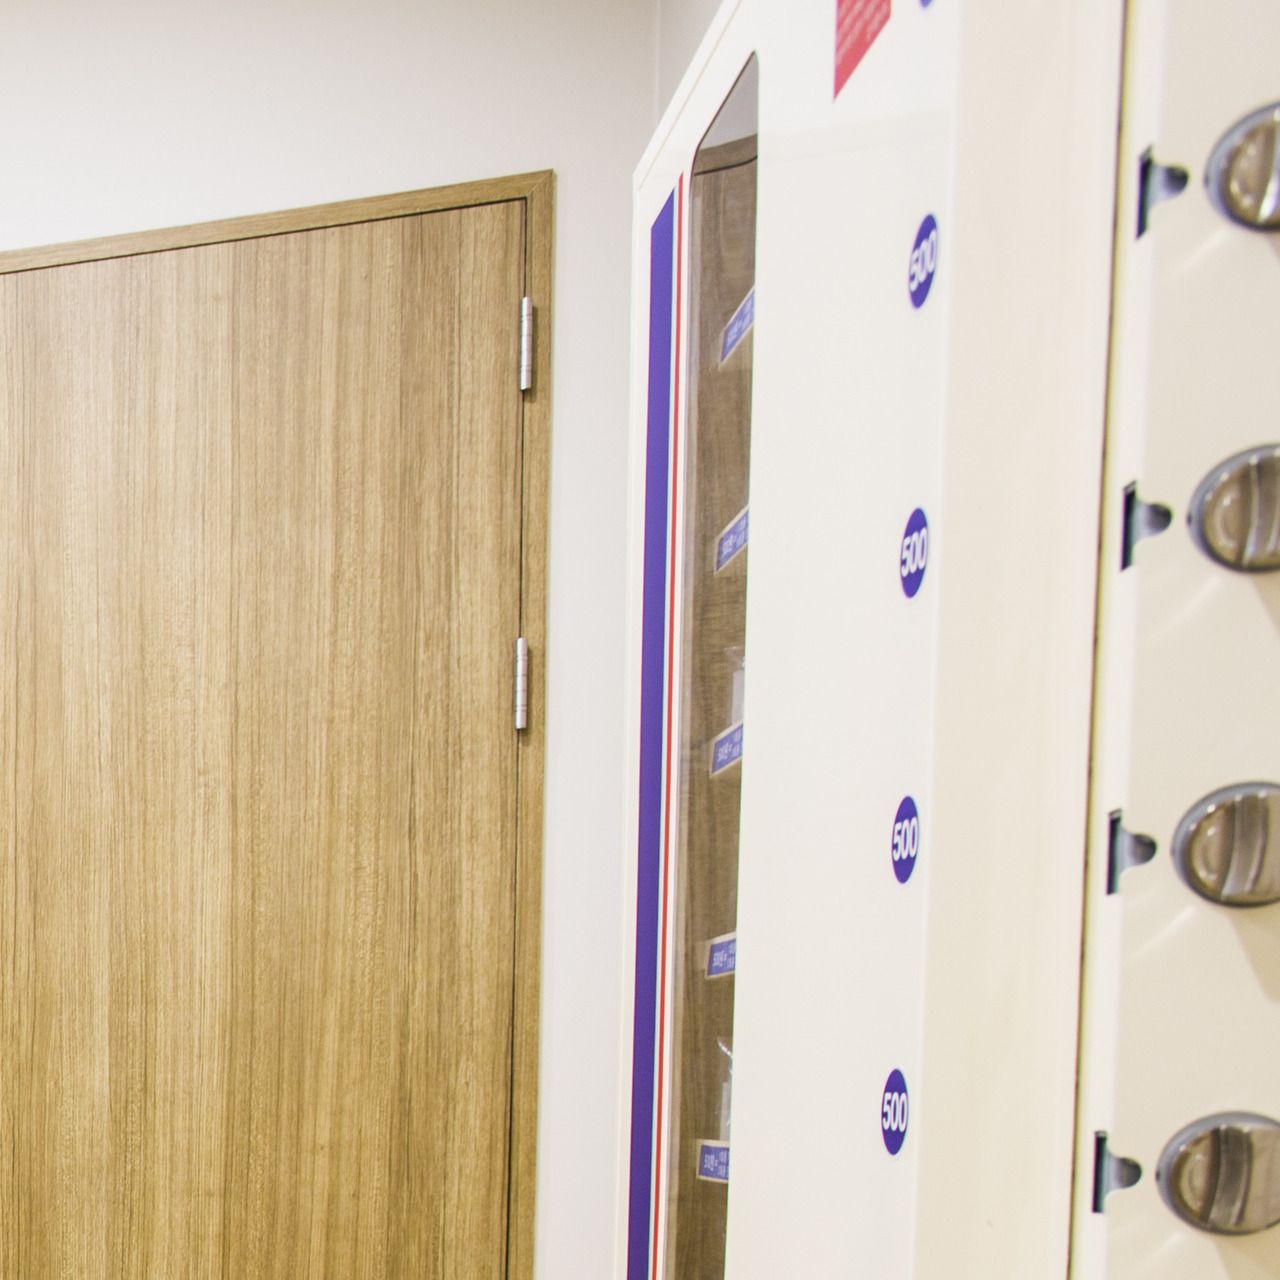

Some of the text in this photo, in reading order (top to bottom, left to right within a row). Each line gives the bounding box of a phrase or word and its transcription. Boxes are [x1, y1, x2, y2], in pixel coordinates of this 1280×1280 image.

[909, 228, 938, 292] 500
[901, 526, 928, 574] 500
[892, 816, 919, 861] 500
[883, 1090, 908, 1132] 500
